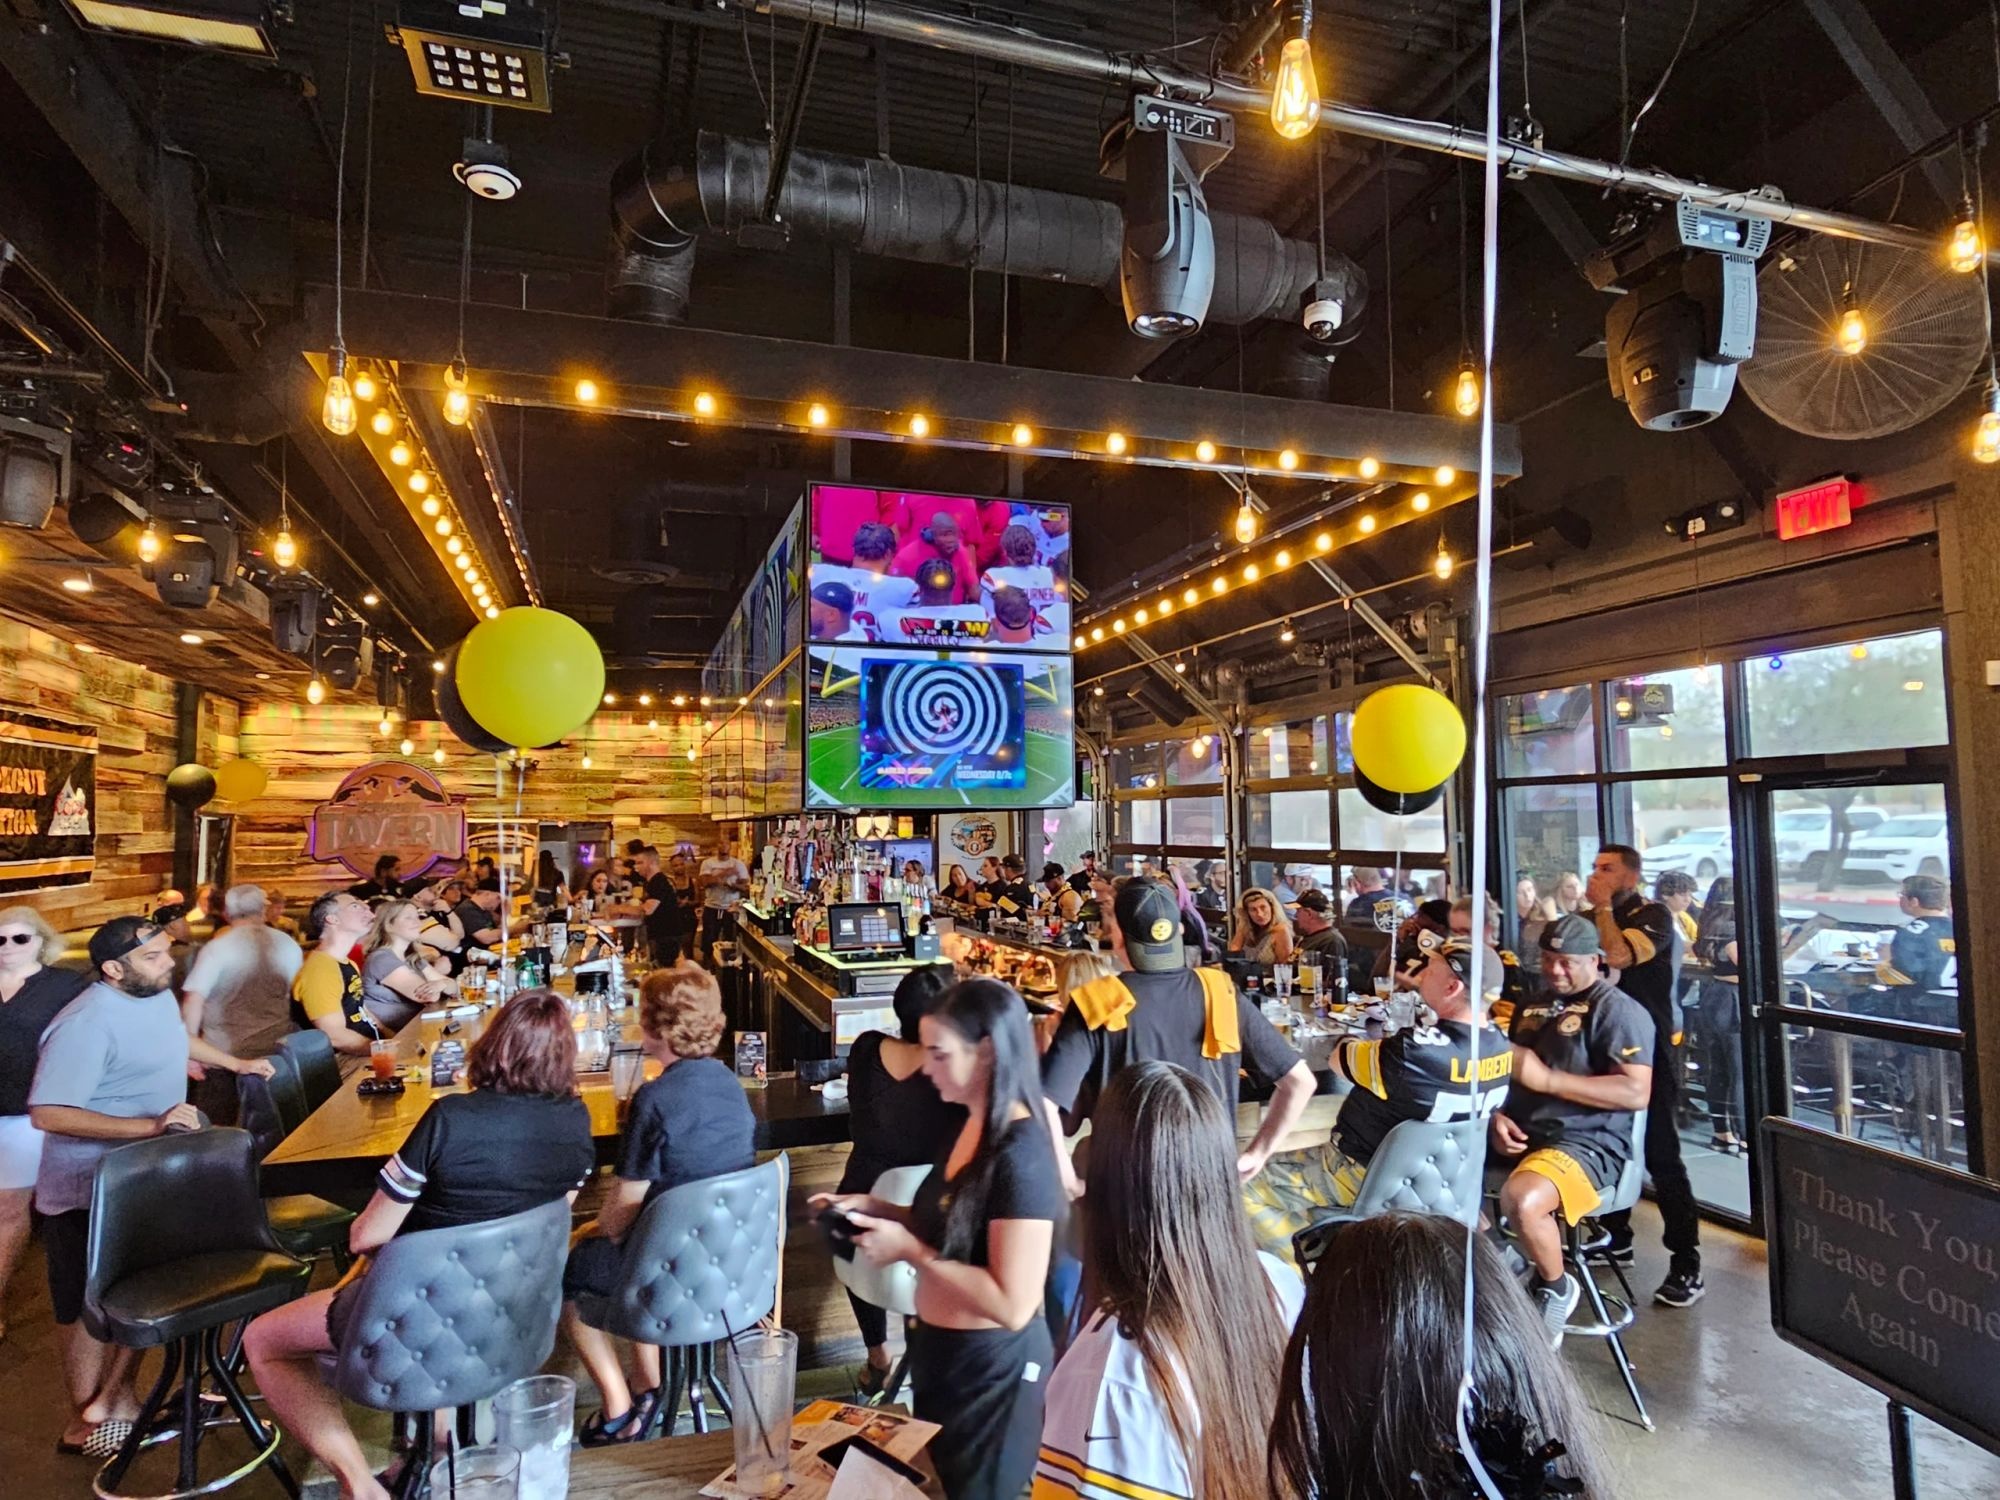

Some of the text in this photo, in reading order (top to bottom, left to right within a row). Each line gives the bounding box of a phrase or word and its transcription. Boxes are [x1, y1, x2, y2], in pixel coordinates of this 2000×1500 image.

[319, 811, 461, 852] TAVERN
[1792, 1167, 1998, 1281] Thank You
[1792, 1219, 2000, 1341] Please Come
[1840, 1292, 1940, 1368] Again
